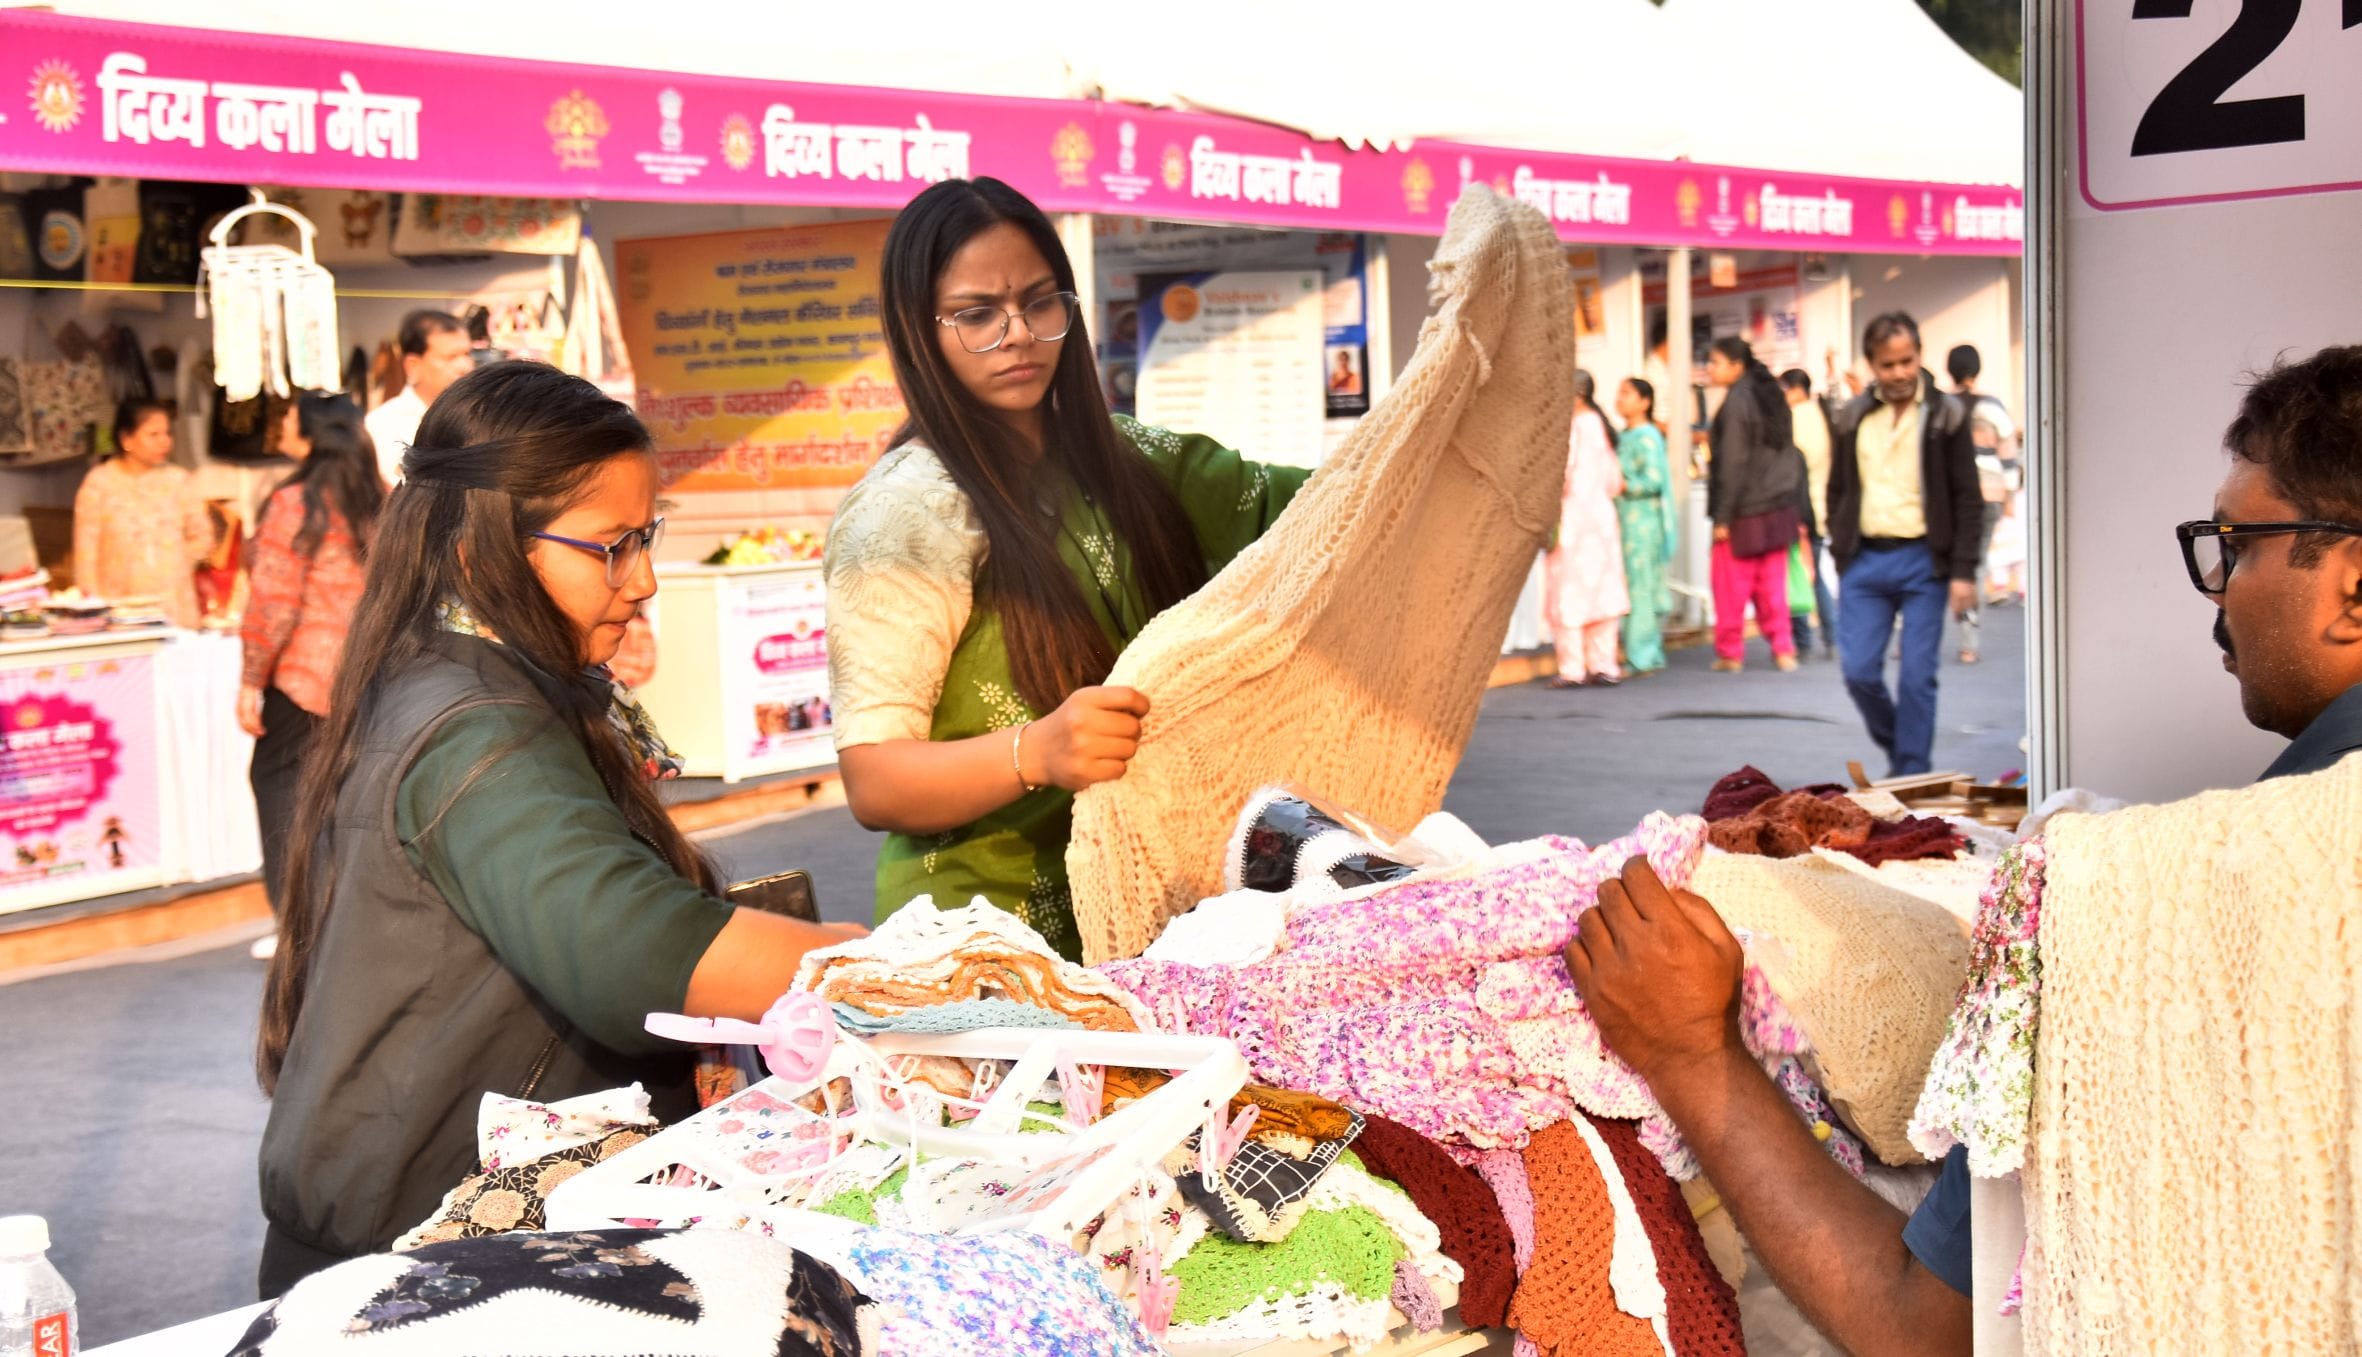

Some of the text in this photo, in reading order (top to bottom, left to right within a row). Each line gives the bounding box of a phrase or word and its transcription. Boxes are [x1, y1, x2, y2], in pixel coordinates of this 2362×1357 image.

[96, 52, 422, 161] दिव्य कला मेला
[2131, 0, 2362, 156] 2
[761, 103, 834, 179] दिव्य
[833, 124, 902, 182] कला
[902, 113, 972, 184] मेला
[1190, 136, 1240, 201] दिव्य
[1241, 155, 1291, 205] कला
[1291, 148, 1342, 208] मेला
[41, 1320, 62, 1357] AR
